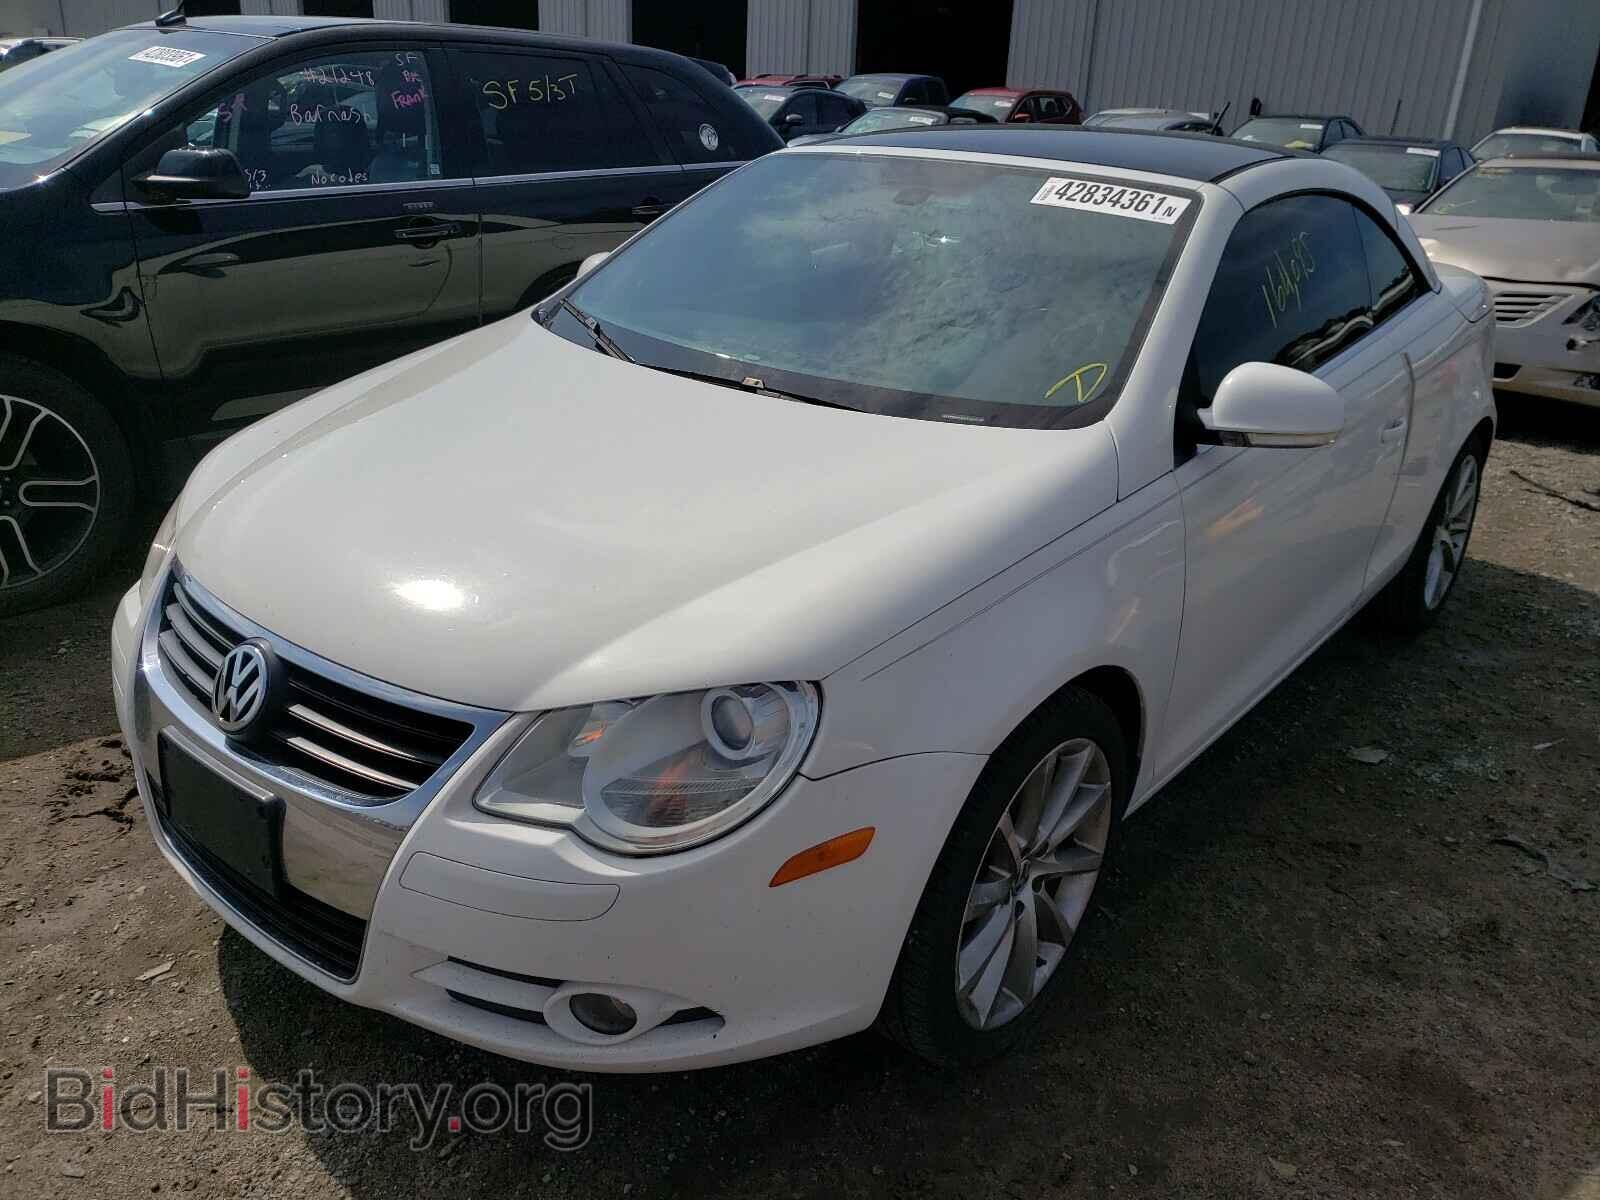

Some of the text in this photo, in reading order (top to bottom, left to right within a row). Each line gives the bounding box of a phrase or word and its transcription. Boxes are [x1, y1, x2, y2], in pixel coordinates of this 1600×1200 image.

[482, 79, 519, 109] SF
[1055, 180, 1168, 215] 42834361
[1162, 206, 1178, 218] N
